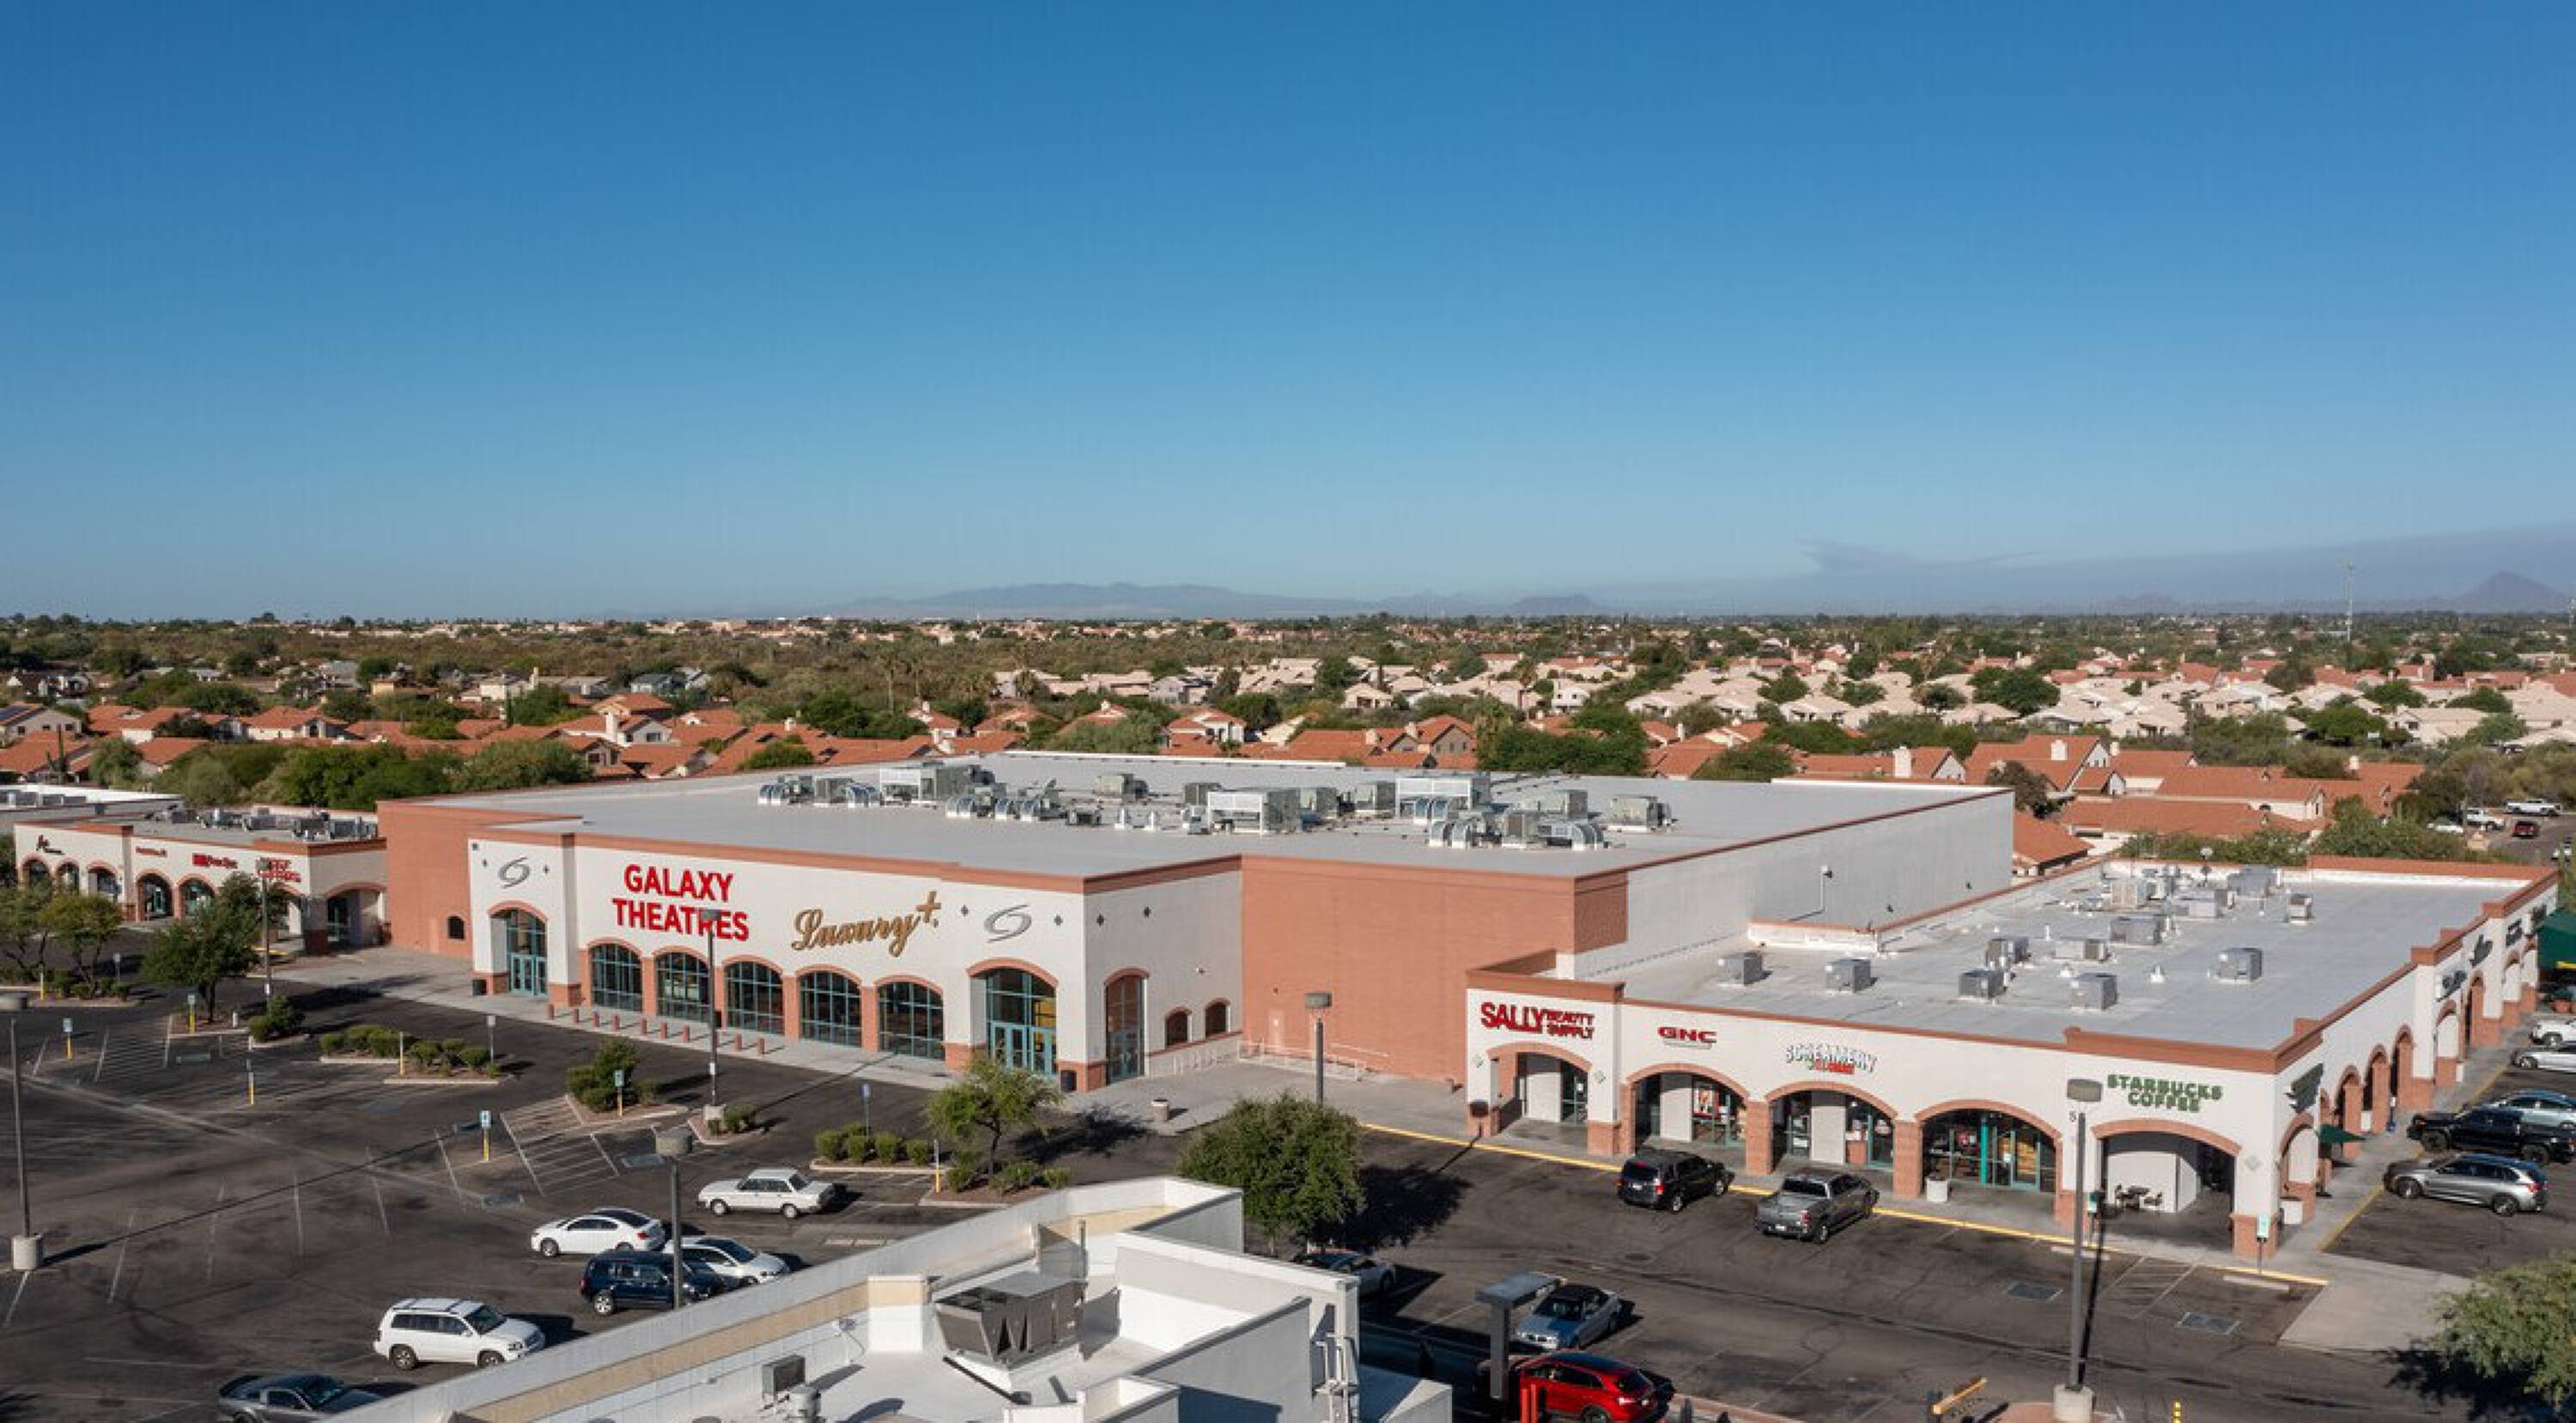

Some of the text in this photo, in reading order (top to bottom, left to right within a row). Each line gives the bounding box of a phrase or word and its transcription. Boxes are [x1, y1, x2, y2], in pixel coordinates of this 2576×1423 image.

[623, 863, 733, 903] GALAXY
[1480, 1001, 1547, 1035] SALLY
[1657, 1026, 1717, 1043] GNC
[2106, 1073, 2223, 1100] STARBUCKS
[2128, 1092, 2201, 1114] COFFEE
